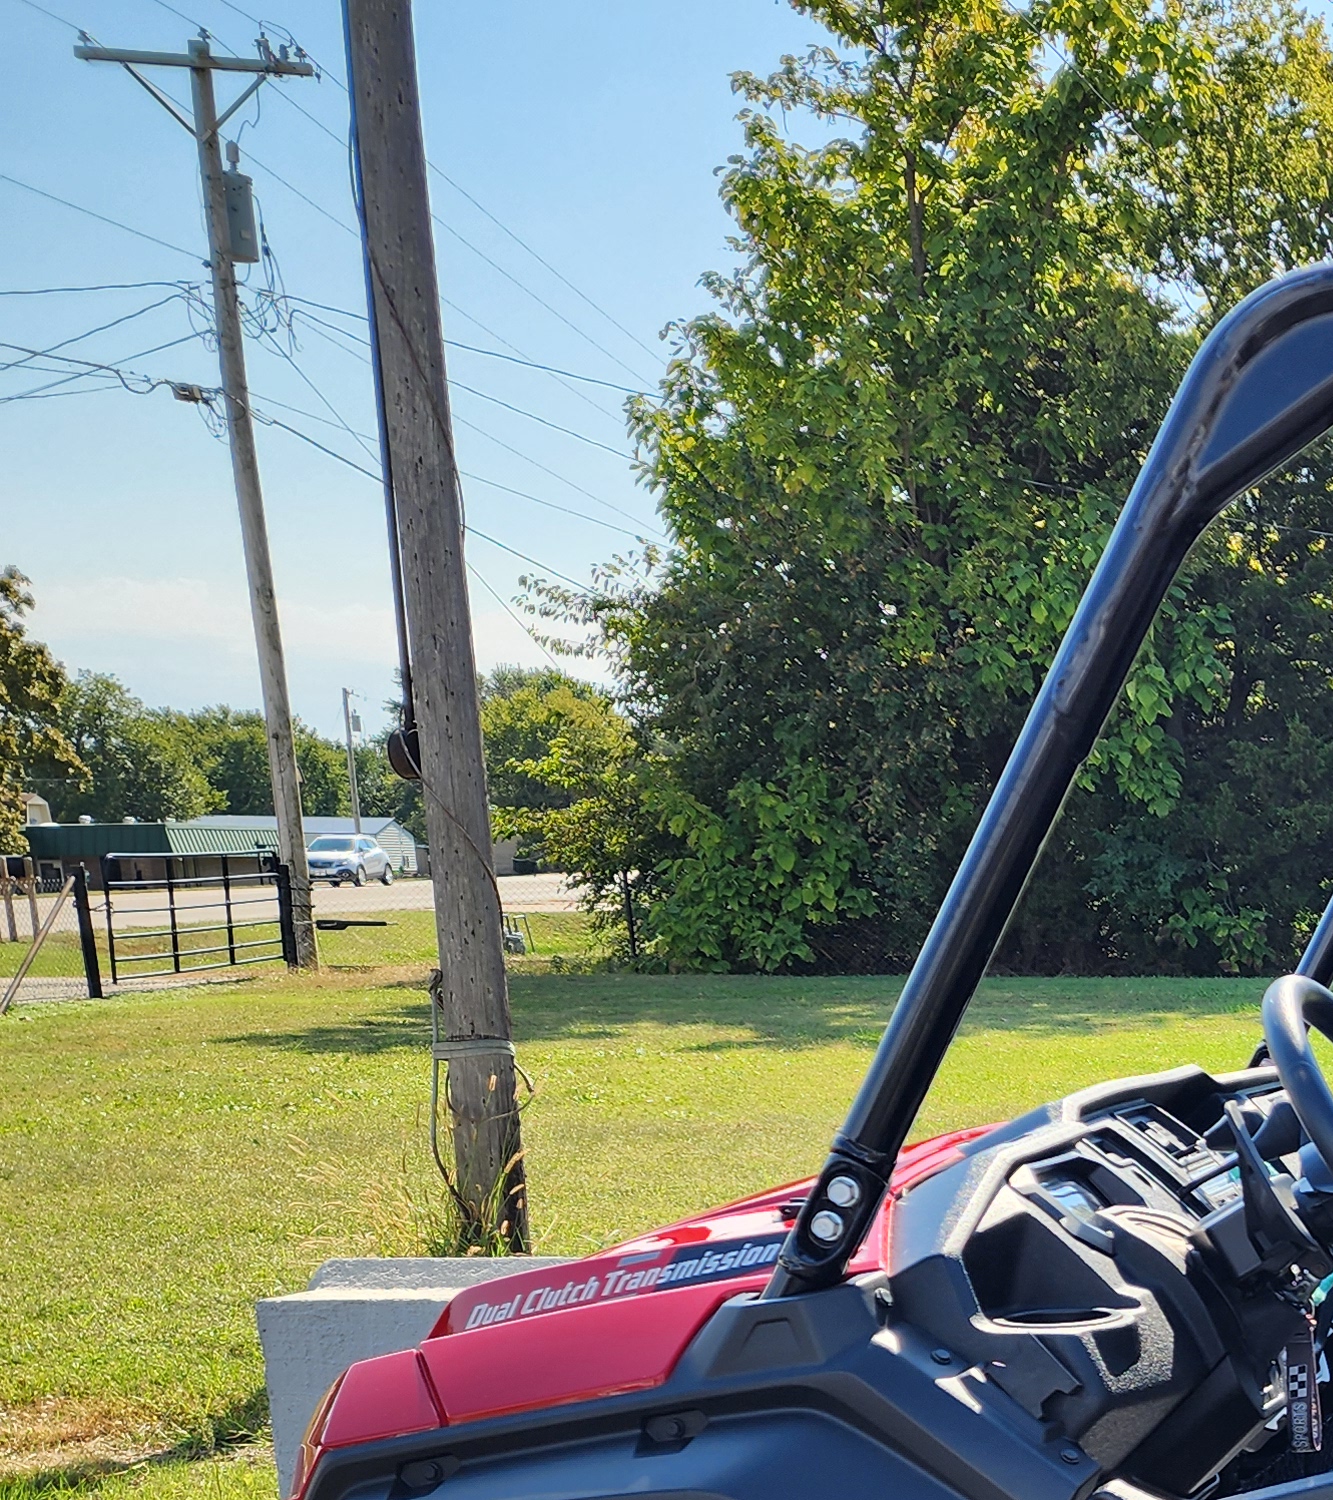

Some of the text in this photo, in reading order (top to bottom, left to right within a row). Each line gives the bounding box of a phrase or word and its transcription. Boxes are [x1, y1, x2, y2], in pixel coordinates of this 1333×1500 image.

[465, 1241, 782, 1330] Dual Clutch Transmission
[1292, 1401, 1308, 1449] SPORTS
